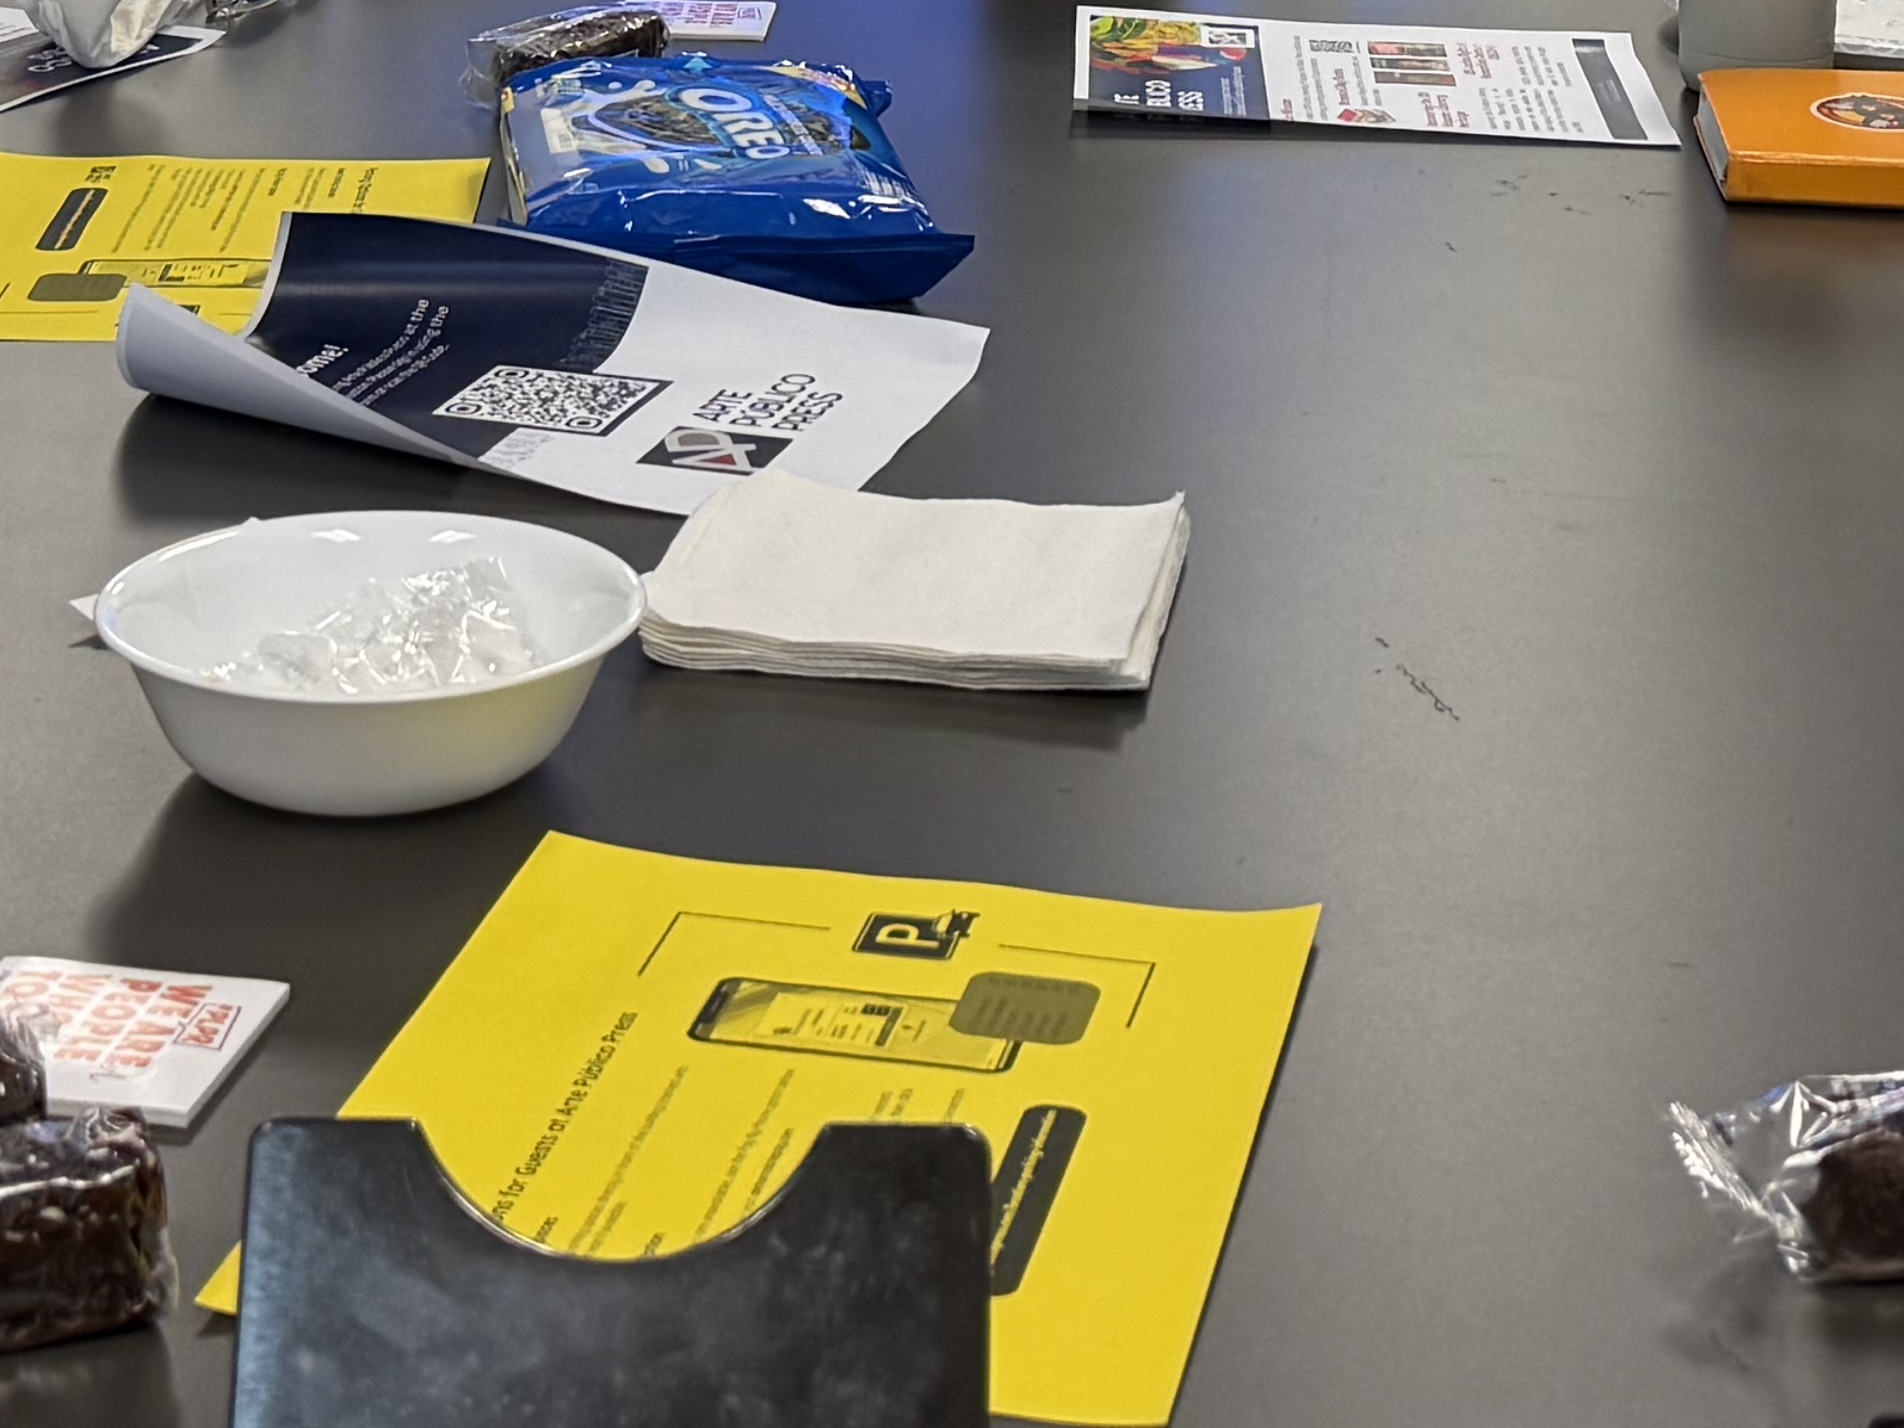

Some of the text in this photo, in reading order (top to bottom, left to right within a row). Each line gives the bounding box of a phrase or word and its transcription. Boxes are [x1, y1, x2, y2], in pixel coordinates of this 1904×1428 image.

[680, 88, 790, 159] OREO
[411, 299, 429, 324] the
[431, 305, 449, 328] the
[692, 389, 752, 422] ARTE
[771, 392, 843, 431] PRESS
[876, 922, 939, 949] P
[54, 978, 163, 1061] PEOPLE
[106, 985, 212, 1067] WE ARE
[600, 1012, 638, 1044] Press
[572, 1045, 616, 1088] Público
[555, 1089, 588, 1117] Arte
[547, 1118, 568, 1132] at
[514, 1134, 559, 1176] Guests
[498, 1177, 527, 1198] for
